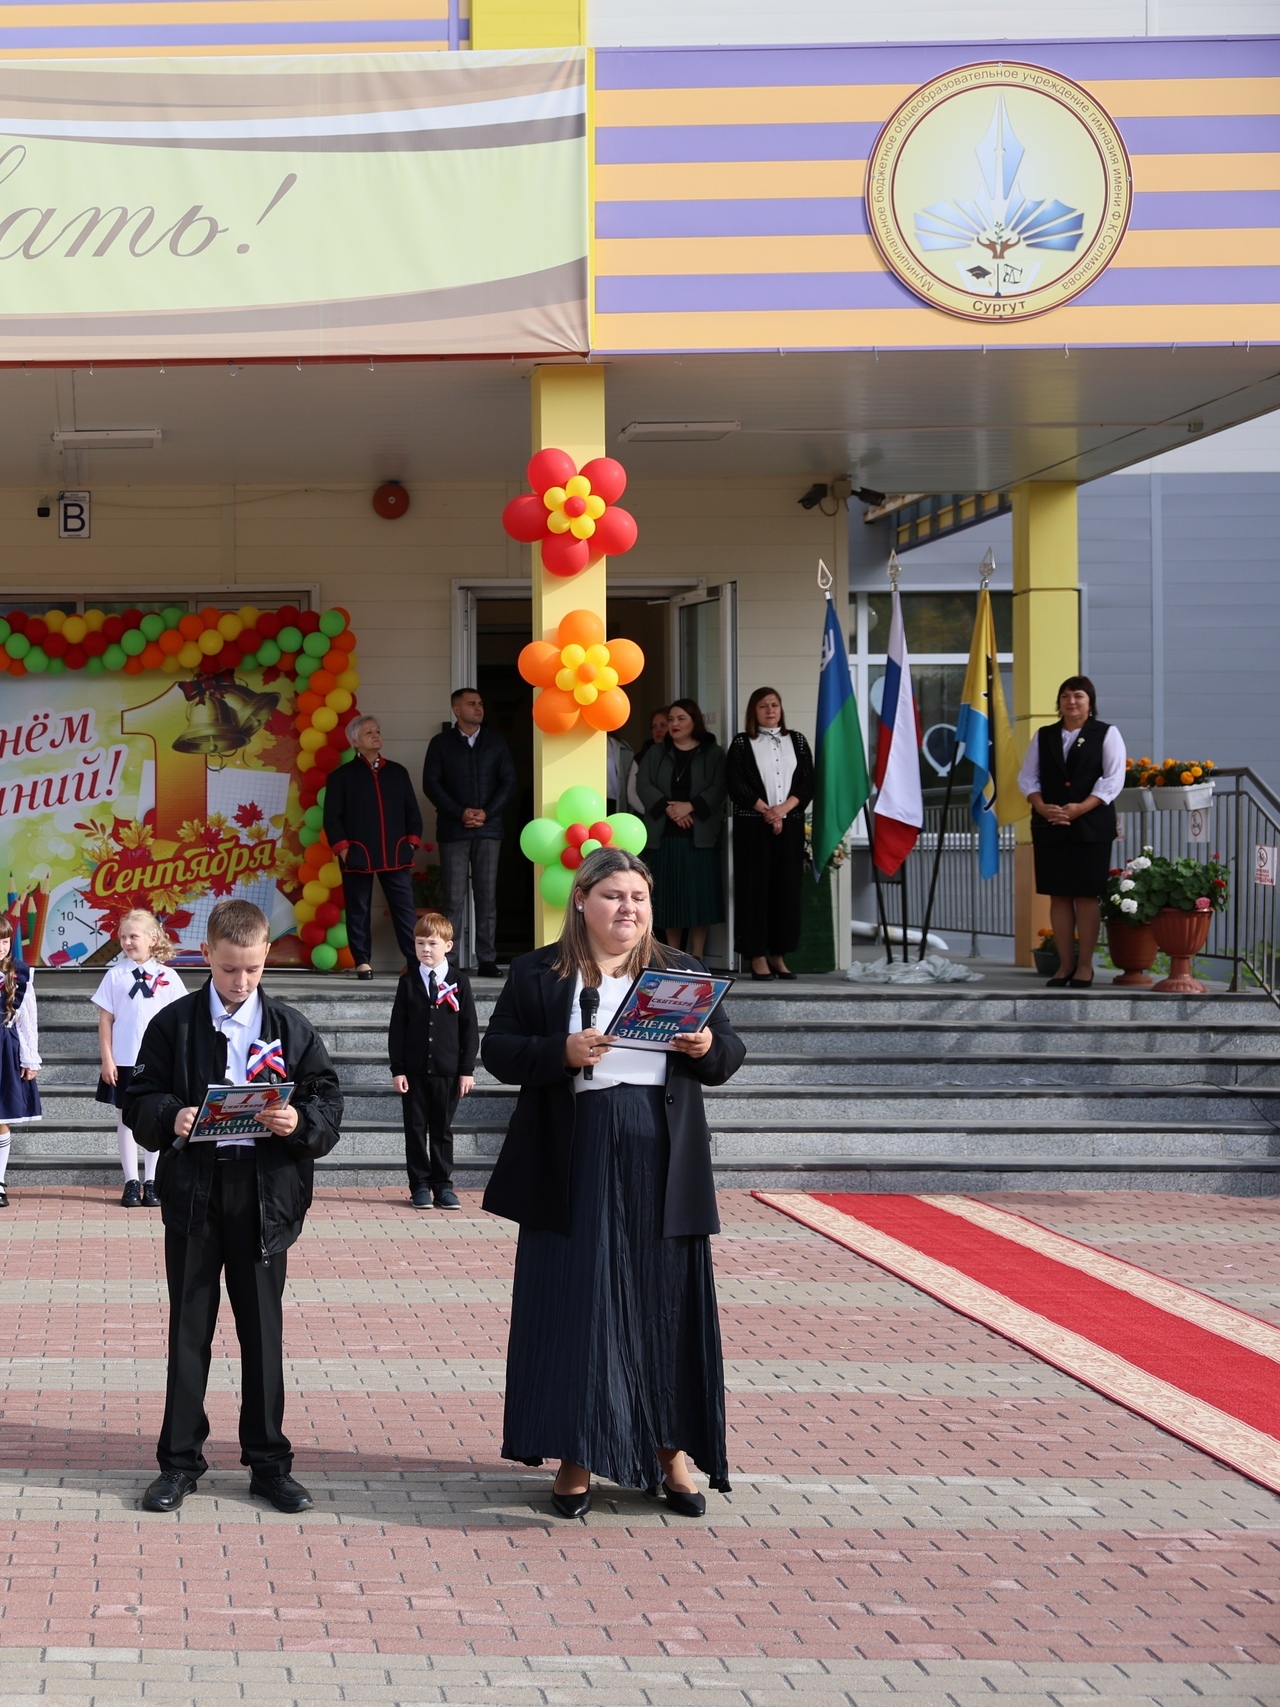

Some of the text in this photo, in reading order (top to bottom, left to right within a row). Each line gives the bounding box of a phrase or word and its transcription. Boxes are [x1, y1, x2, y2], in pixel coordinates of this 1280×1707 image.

[1021, 70, 1090, 114] учреждение
[894, 68, 1019, 135] общеобразовательное
[1088, 112, 1120, 166] гимназия
[873, 134, 896, 204] бюджетное
[1113, 167, 1123, 208] имени
[873, 206, 935, 292] Муниципальное
[972, 299, 1027, 315] Сургут
[93, 836, 277, 898] Сентября
[73, 899, 85, 909] 11
[60, 911, 74, 921] 10
[57, 926, 65, 936] 9
[668, 984, 689, 999] 1
[651, 998, 693, 1007] СЕНТЯБРЯ
[635, 1019, 680, 1031] ДЕНЬ
[617, 1028, 675, 1041] ЗНАНИ
[238, 1093, 255, 1104] 1
[199, 1125, 267, 1135] ЗНАНИЙ
[214, 1119, 258, 1127] ДЕНЬ
